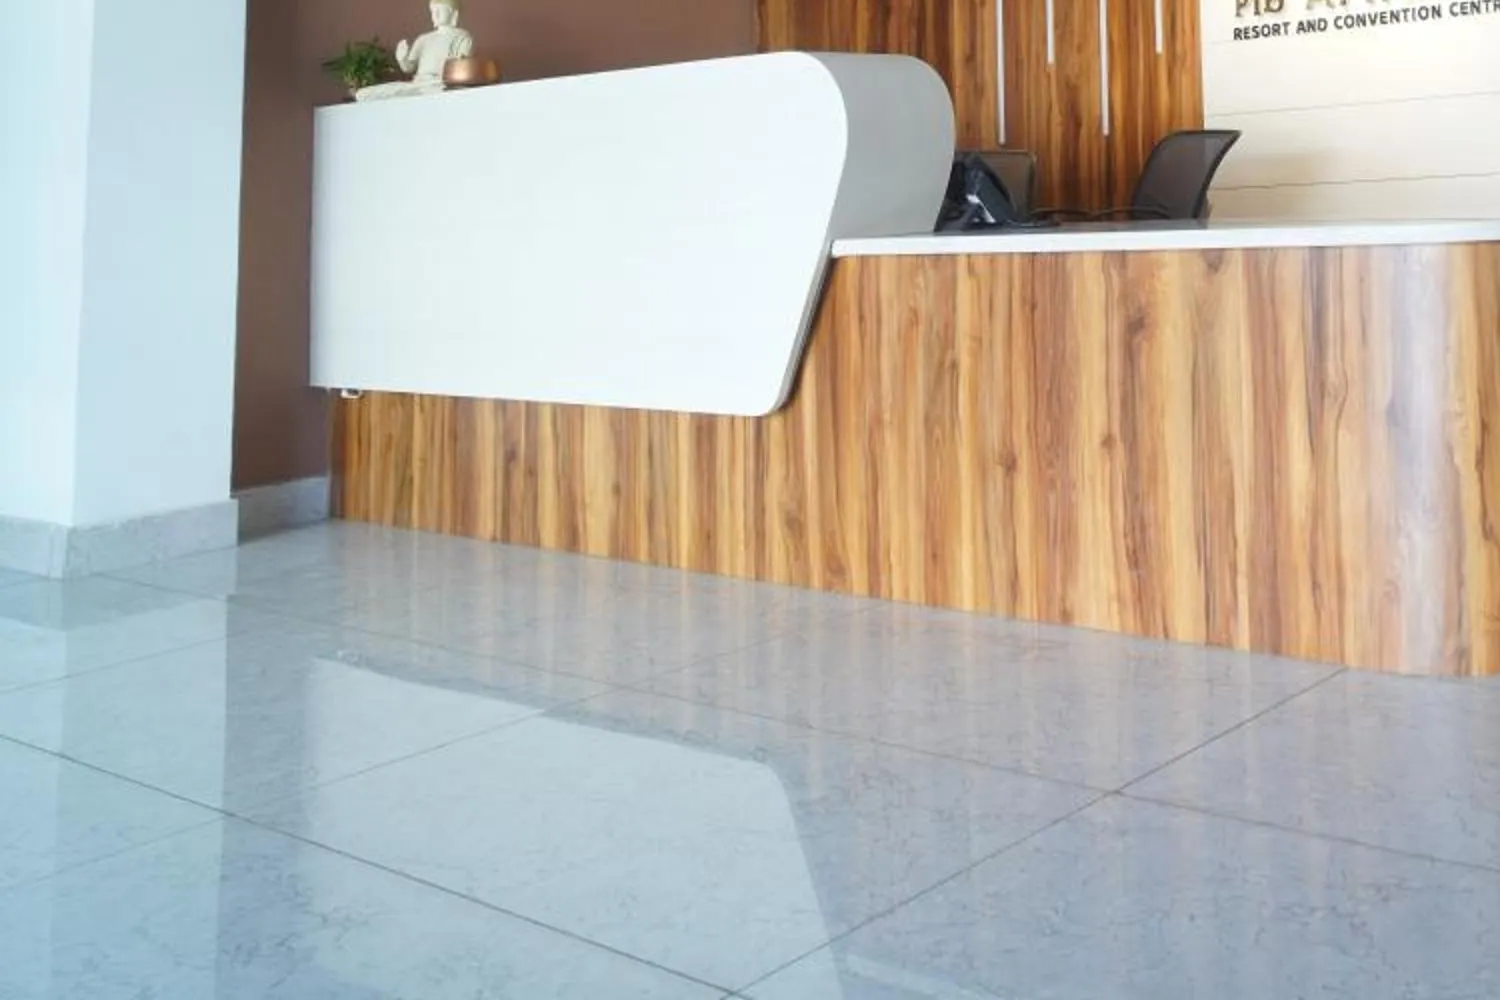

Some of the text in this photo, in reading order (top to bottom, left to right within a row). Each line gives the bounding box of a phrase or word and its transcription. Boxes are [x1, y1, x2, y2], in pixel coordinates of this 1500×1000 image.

[1233, 21, 1291, 41] RESORT
[1296, 17, 1328, 35] AND
[1333, 4, 1442, 30] CONVENTION
